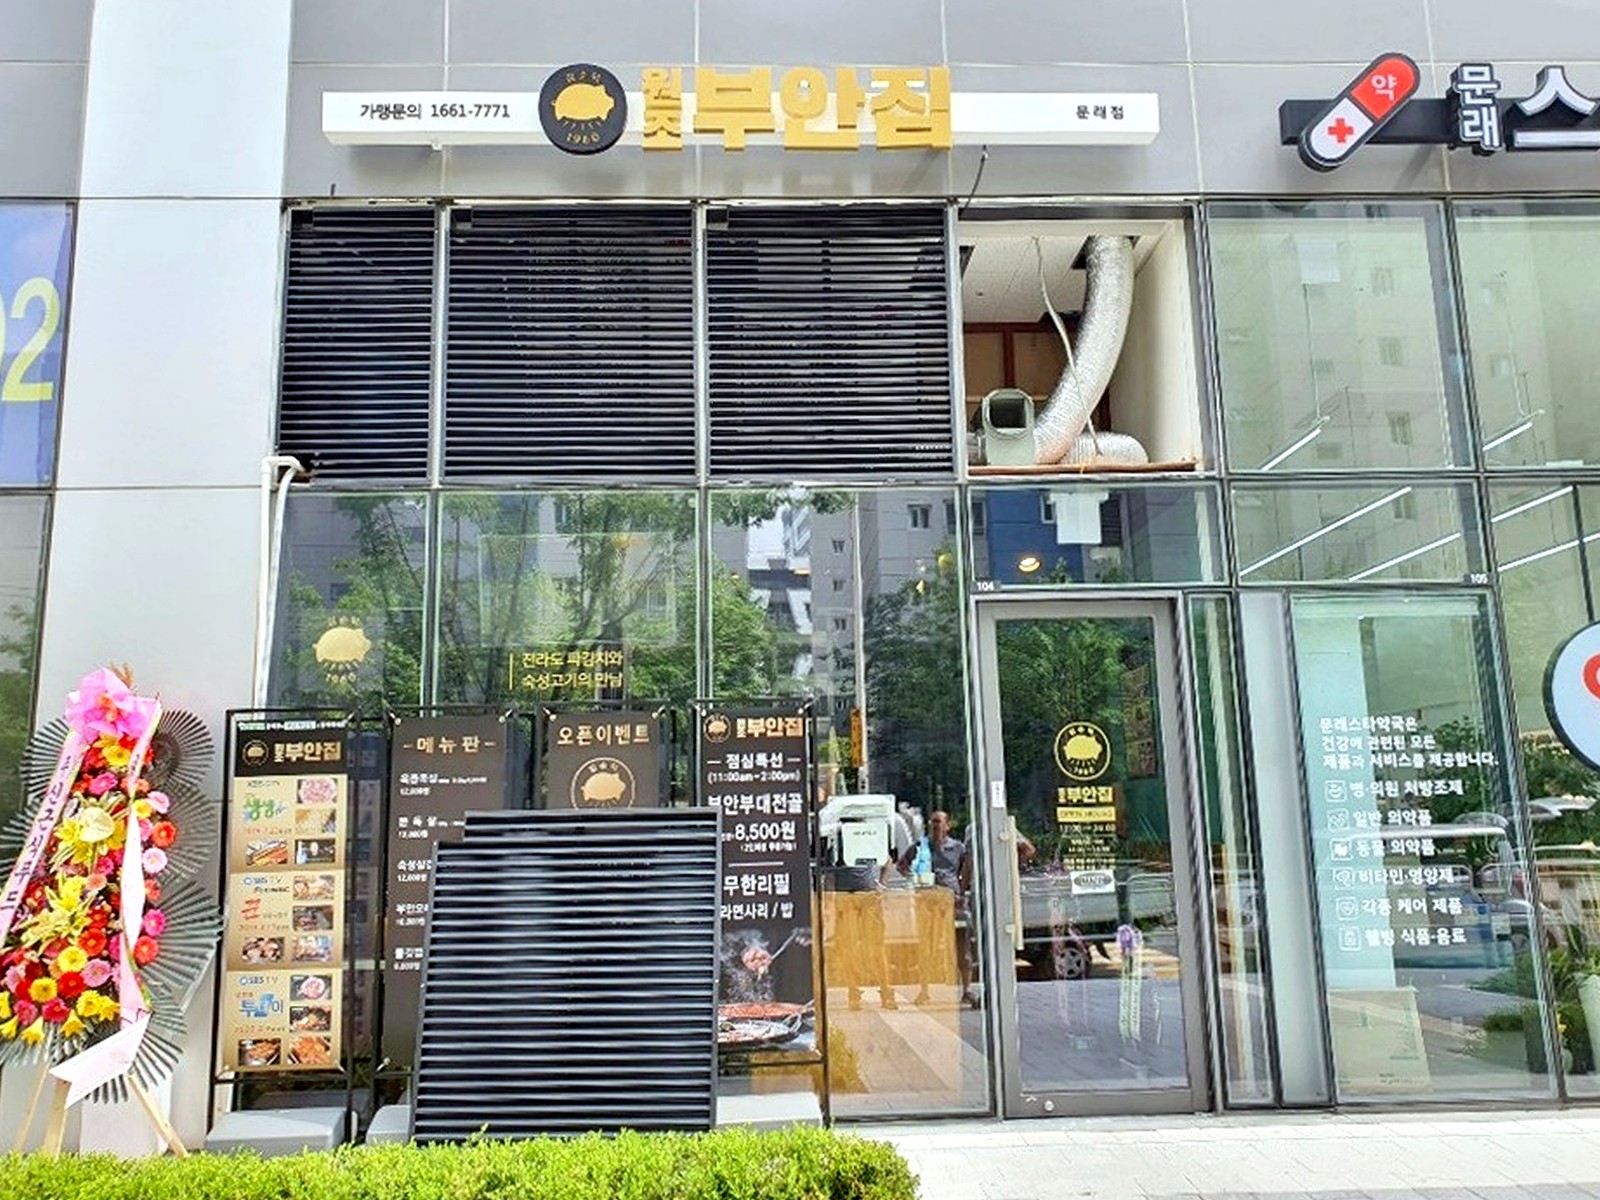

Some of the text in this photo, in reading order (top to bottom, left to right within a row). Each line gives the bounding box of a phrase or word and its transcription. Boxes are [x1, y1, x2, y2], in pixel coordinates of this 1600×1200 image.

[1371, 74, 1397, 100] 약
[360, 103, 510, 120] 가맹문의 1661-7771
[642, 66, 952, 151] 원조 부안집
[1076, 105, 1124, 120] 문래점
[1455, 63, 1503, 150] 문래
[976, 582, 995, 591] 104
[522, 651, 623, 668] 전라도 파김치와
[523, 671, 623, 690] 숙성고기의 만남
[557, 723, 650, 746] 오픈이벤트
[747, 717, 804, 737] 부안집
[285, 741, 341, 762] 부안집
[1321, 735, 1363, 751] 건강에
[1410, 735, 1436, 750] 모든
[726, 752, 784, 769] 점심특선
[1369, 753, 1426, 768] 서비스를
[1352, 809, 1432, 828] 일반 의약품
[735, 820, 797, 841] 8,500원
[1391, 838, 1436, 857] 의약품
[723, 872, 790, 897] 무한리필
[1398, 897, 1428, 914] 케어
